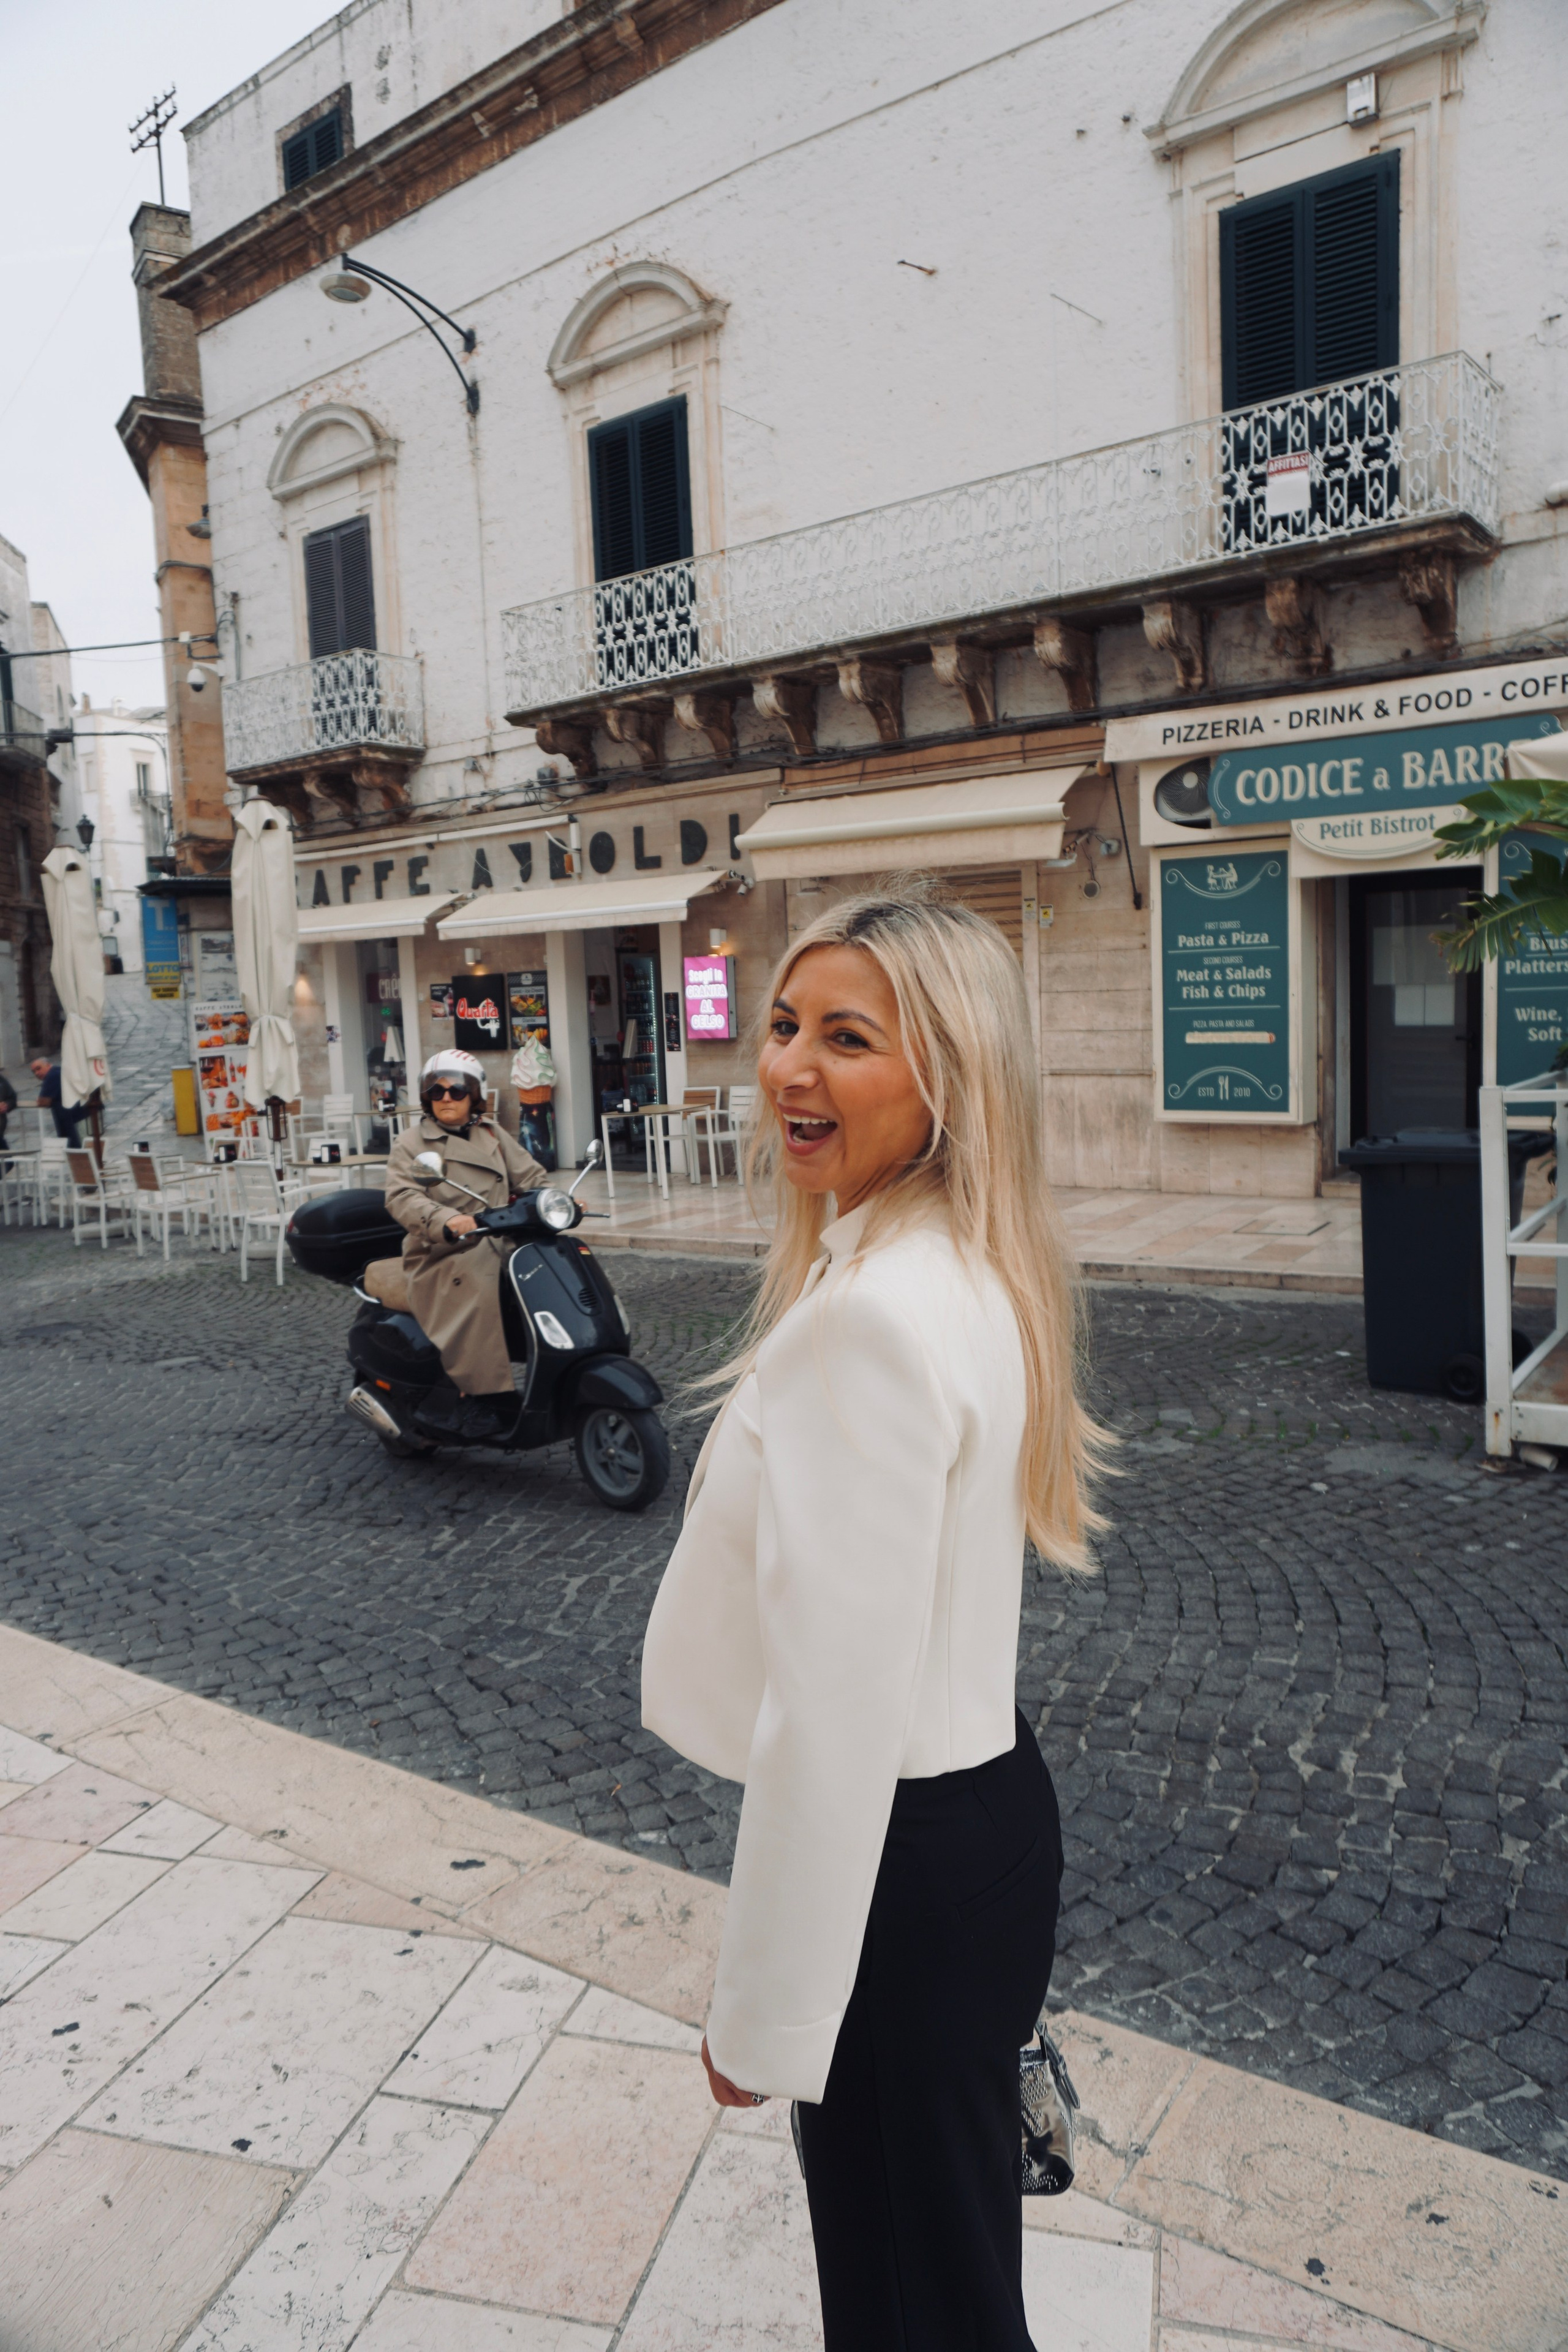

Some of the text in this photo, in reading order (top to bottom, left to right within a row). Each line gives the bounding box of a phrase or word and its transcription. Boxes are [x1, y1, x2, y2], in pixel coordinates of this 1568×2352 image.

[1269, 454, 1308, 473] AFFITTASI
[1163, 715, 1264, 745] PIZZERIA
[1289, 702, 1364, 729] DRINK
[1374, 699, 1390, 719] &
[1400, 688, 1472, 715] FOOD
[1236, 742, 1506, 805] CODICE a BARR
[1320, 813, 1436, 840] Petit Bistrot
[295, 856, 430, 906] AFFE
[1219, 921, 1241, 929] COURSES
[1178, 931, 1269, 948] Pasta & Pizza
[1222, 956, 1243, 964] COURSES
[146, 965, 181, 973] LOTTO
[1177, 965, 1272, 981] Meat & Salads
[685, 984, 728, 1000] GRANITA
[1182, 984, 1266, 1000] Fish & Chips
[456, 997, 499, 1019] Quarta
[699, 999, 715, 1014] AL
[1515, 1006, 1562, 1022] Wine,
[690, 1014, 726, 1030] GELSO
[1528, 1026, 1562, 1041] Soft
[1234, 1087, 1251, 1096] 2010
